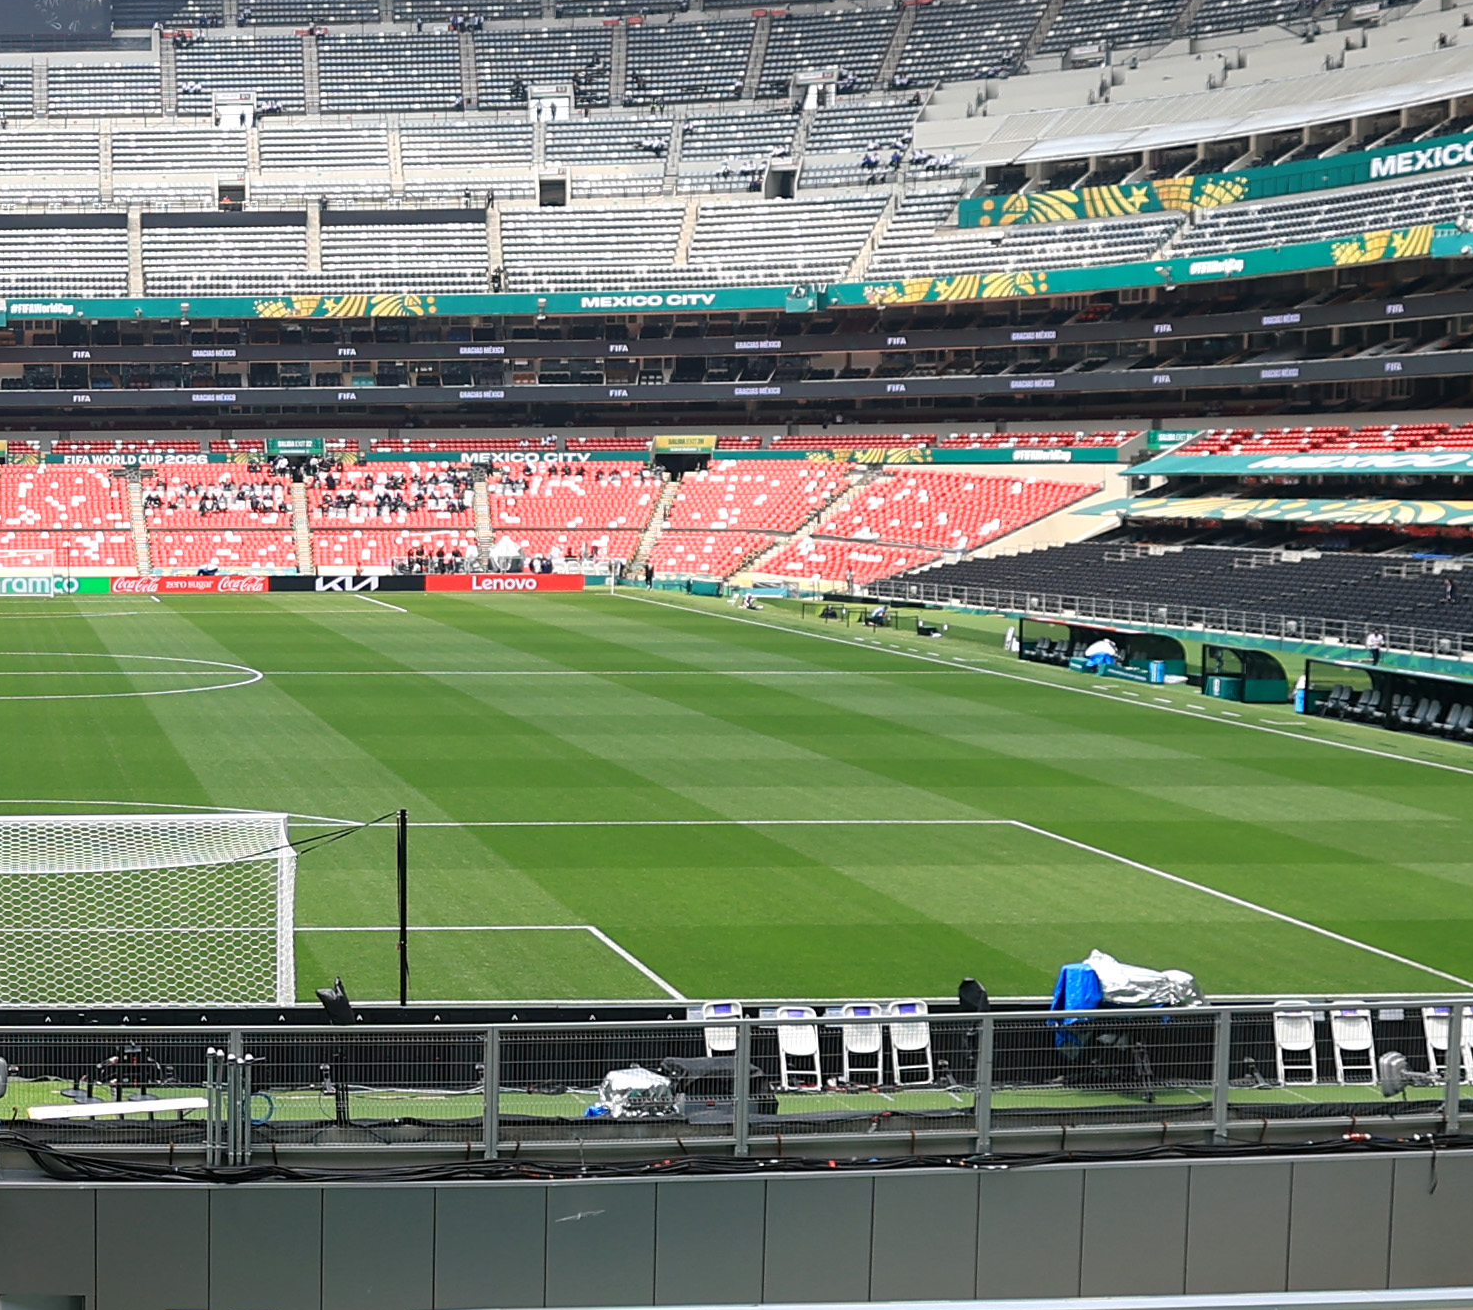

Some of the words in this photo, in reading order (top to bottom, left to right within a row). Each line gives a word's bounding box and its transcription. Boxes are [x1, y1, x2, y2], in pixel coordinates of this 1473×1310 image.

[581, 295, 663, 307] MEXICO
[666, 294, 716, 306] CITY
[338, 348, 357, 357] FIFA
[64, 454, 90, 466] FIFA
[92, 454, 135, 466] WORLD
[137, 454, 163, 466] CUP
[165, 454, 209, 466] 2026
[460, 453, 539, 464] MEXICO
[543, 453, 592, 464] CITY
[1247, 452, 1471, 468] MEXICO
[112, 576, 160, 594] Coca-Cola
[165, 579, 188, 590] zero
[188, 579, 214, 592] sugar
[218, 576, 266, 593] Coca-Cola
[315, 576, 380, 592] KIA
[471, 575, 537, 591] Lenovo
